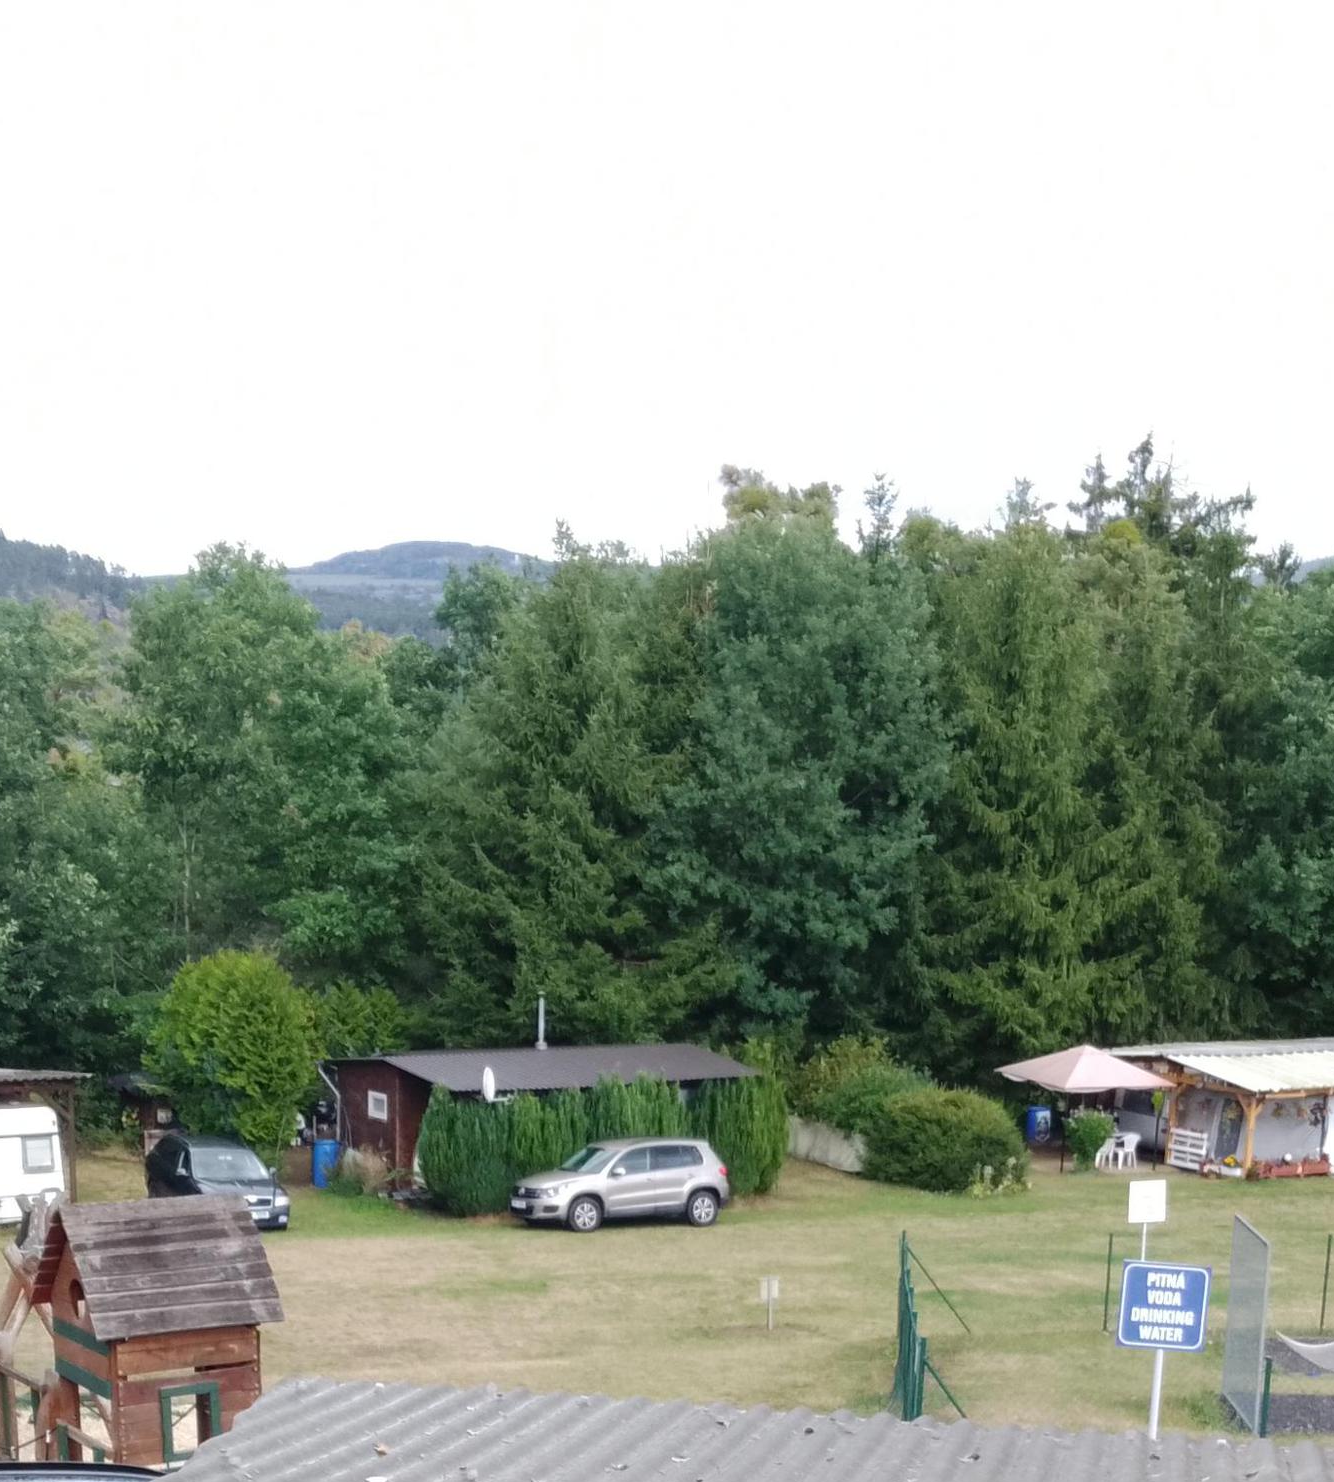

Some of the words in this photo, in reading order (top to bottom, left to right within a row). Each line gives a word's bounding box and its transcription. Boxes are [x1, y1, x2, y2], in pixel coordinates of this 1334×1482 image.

[1147, 1271, 1185, 1289] PITNÁ
[1147, 1289, 1181, 1306] VODA
[1131, 1307, 1194, 1326] DRINKING
[1139, 1325, 1183, 1342] WATER
